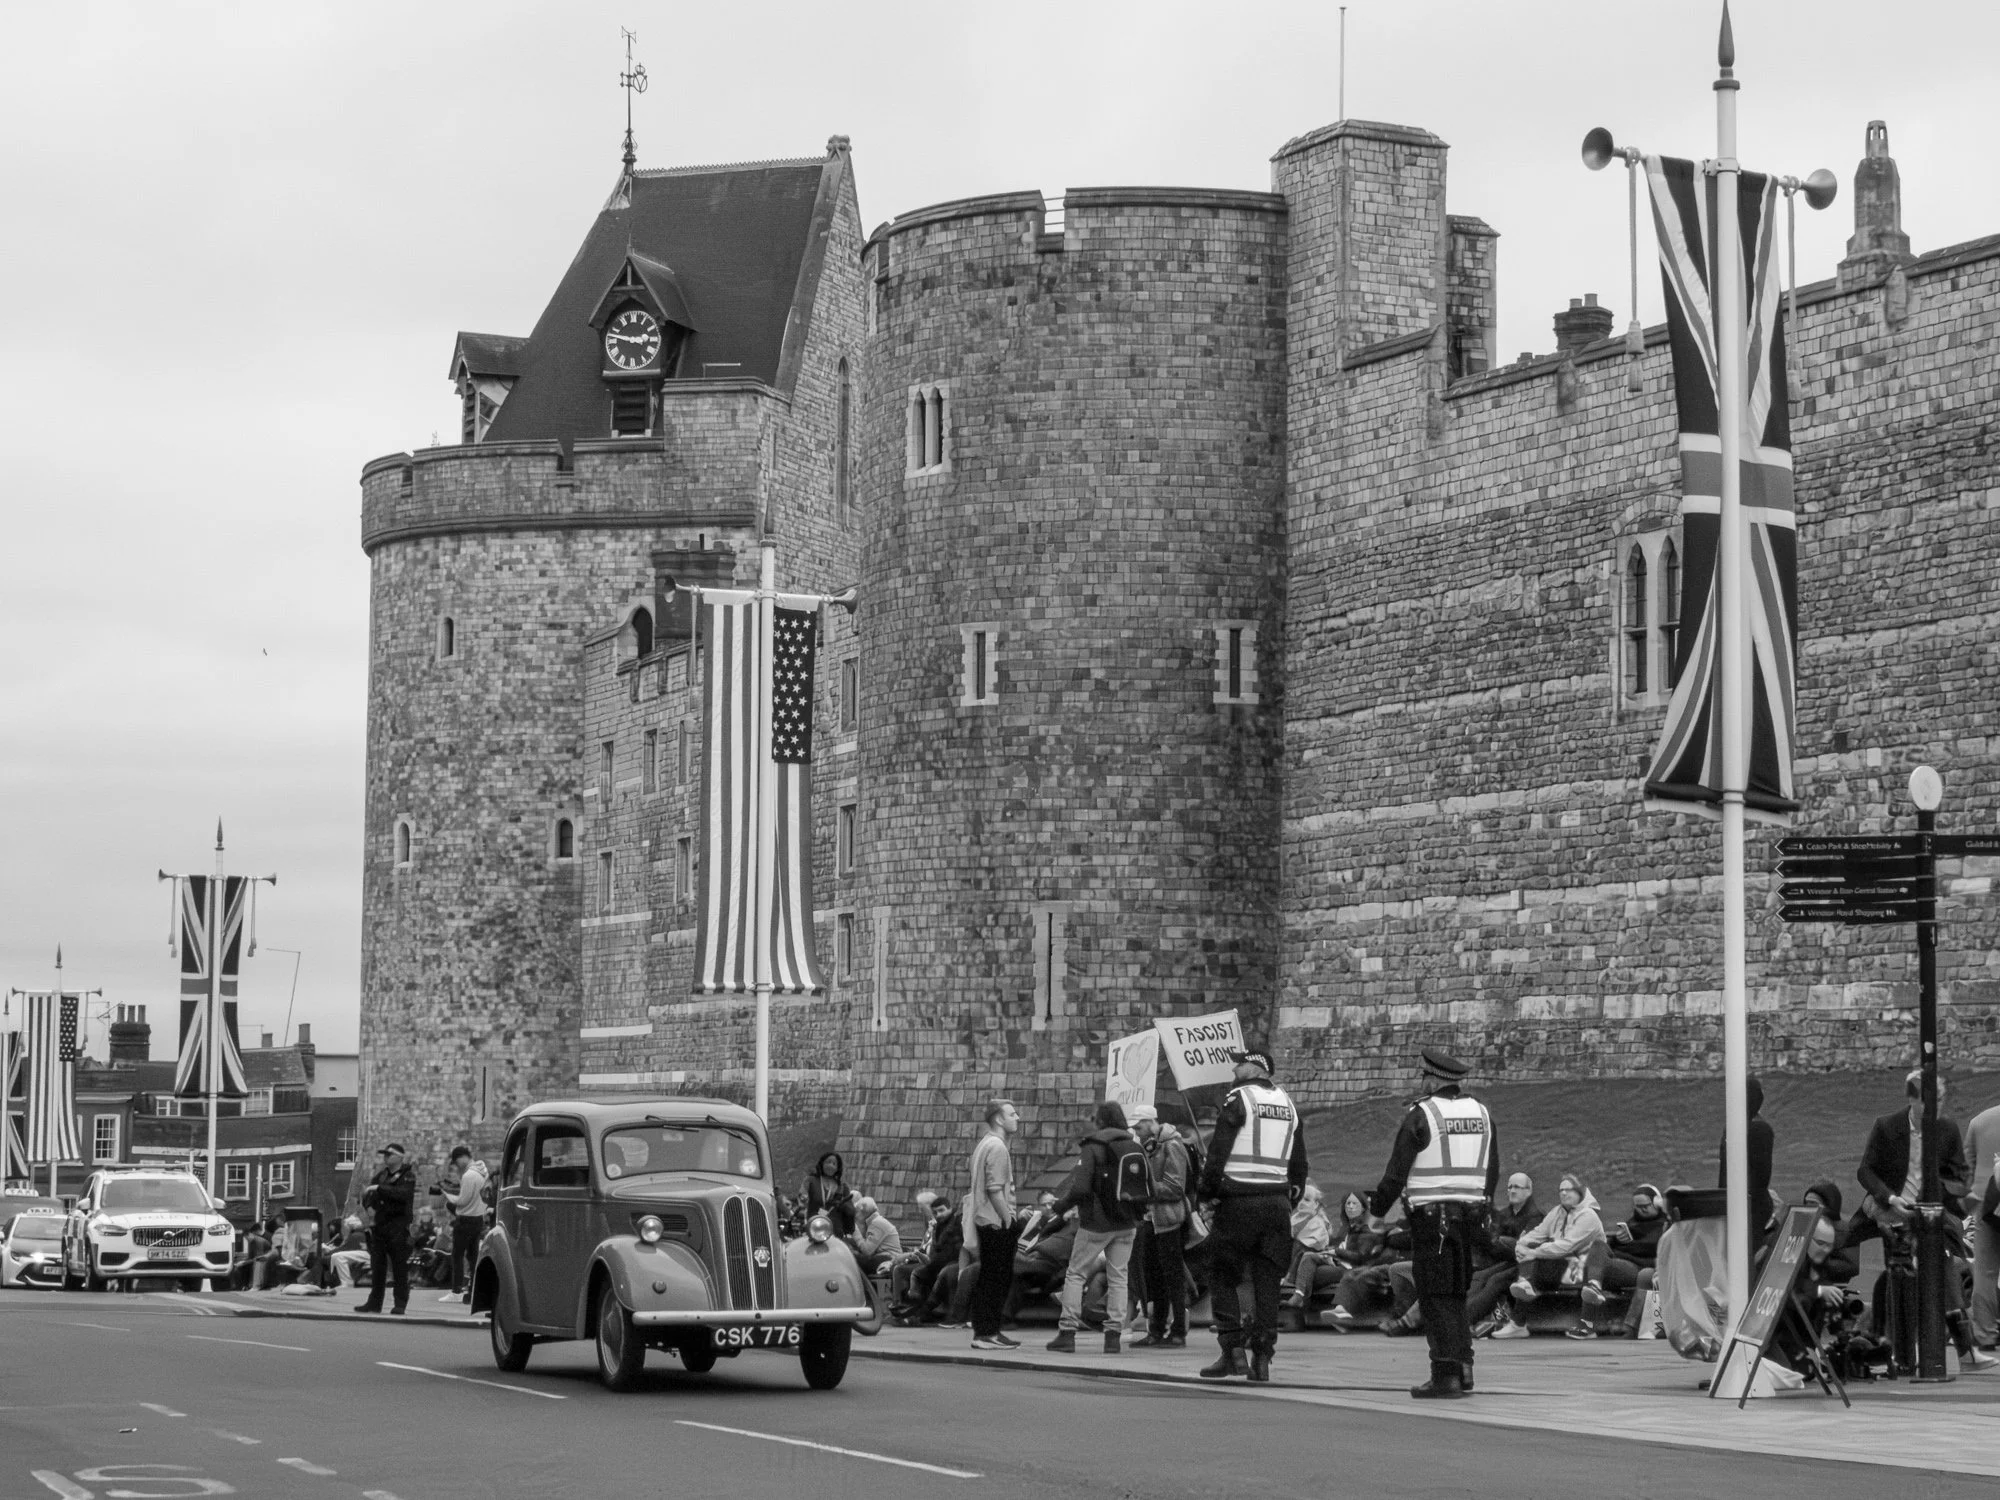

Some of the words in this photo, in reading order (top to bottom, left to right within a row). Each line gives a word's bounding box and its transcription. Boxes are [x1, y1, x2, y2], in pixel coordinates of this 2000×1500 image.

[1828, 842, 1842, 850] Park
[1174, 1021, 1234, 1045] FASCIST
[1112, 1047, 1121, 1077] I
[1183, 1048, 1205, 1067] GO
[1258, 1104, 1291, 1120] POLICE
[1445, 1119, 1484, 1133] POLICE
[715, 1327, 754, 1346] CSK
[760, 1326, 800, 1345] 776
